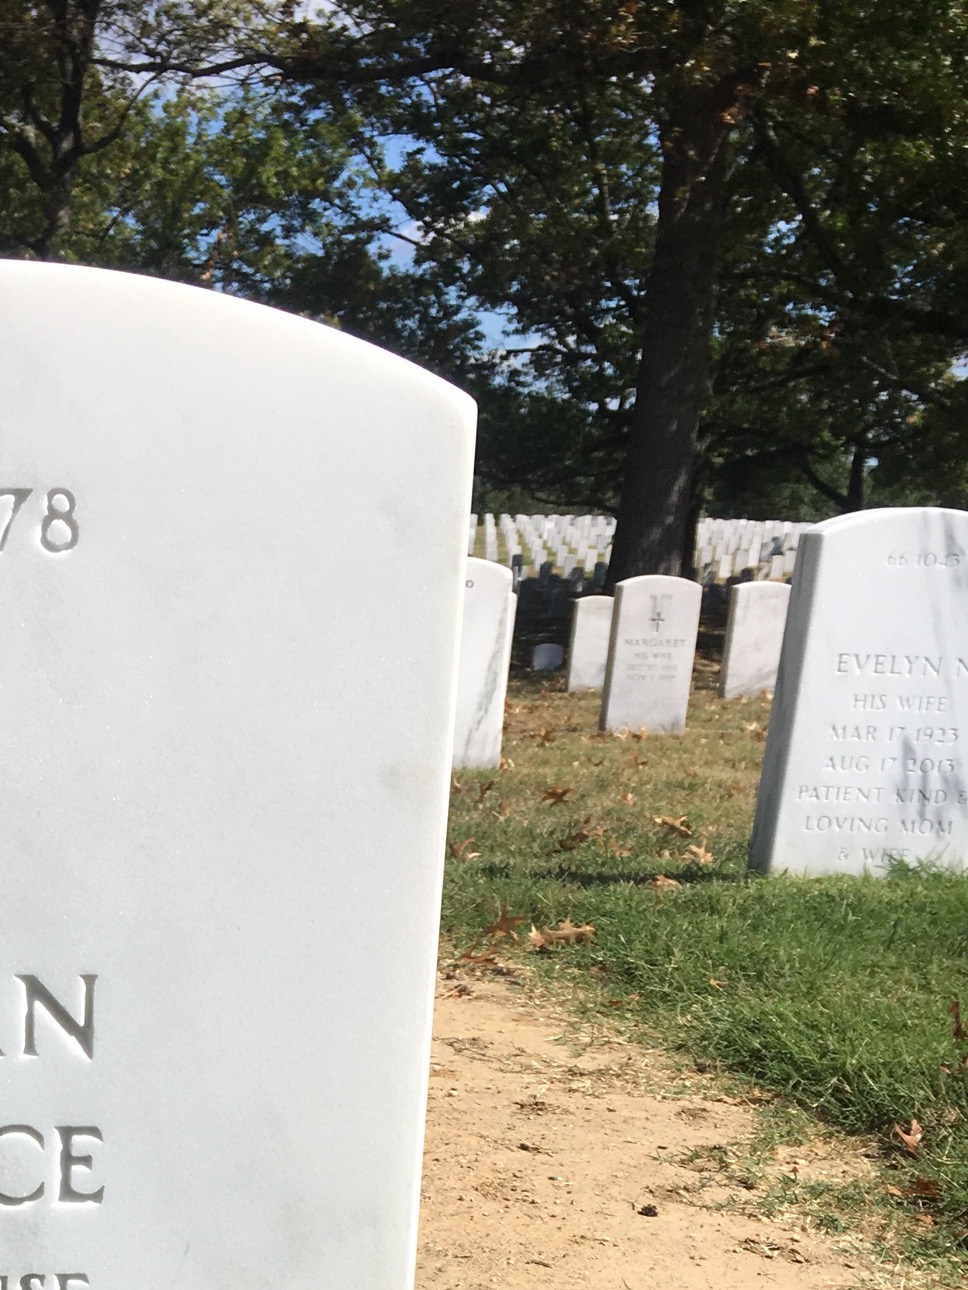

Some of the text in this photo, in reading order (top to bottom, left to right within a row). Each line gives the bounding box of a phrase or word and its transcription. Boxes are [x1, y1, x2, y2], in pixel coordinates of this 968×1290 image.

[887, 551, 908, 566] 66
[624, 639, 686, 648] MARGARET
[836, 653, 943, 676] EVELYN
[852, 694, 948, 712] HIS WIFE
[830, 724, 959, 743] MAR 17 1923
[825, 756, 955, 774] AUG 17 2013
[799, 784, 885, 802] PATIENT
[895, 788, 948, 804] KIND
[804, 815, 953, 835] LOVING MOM
[838, 847, 849, 862] &
